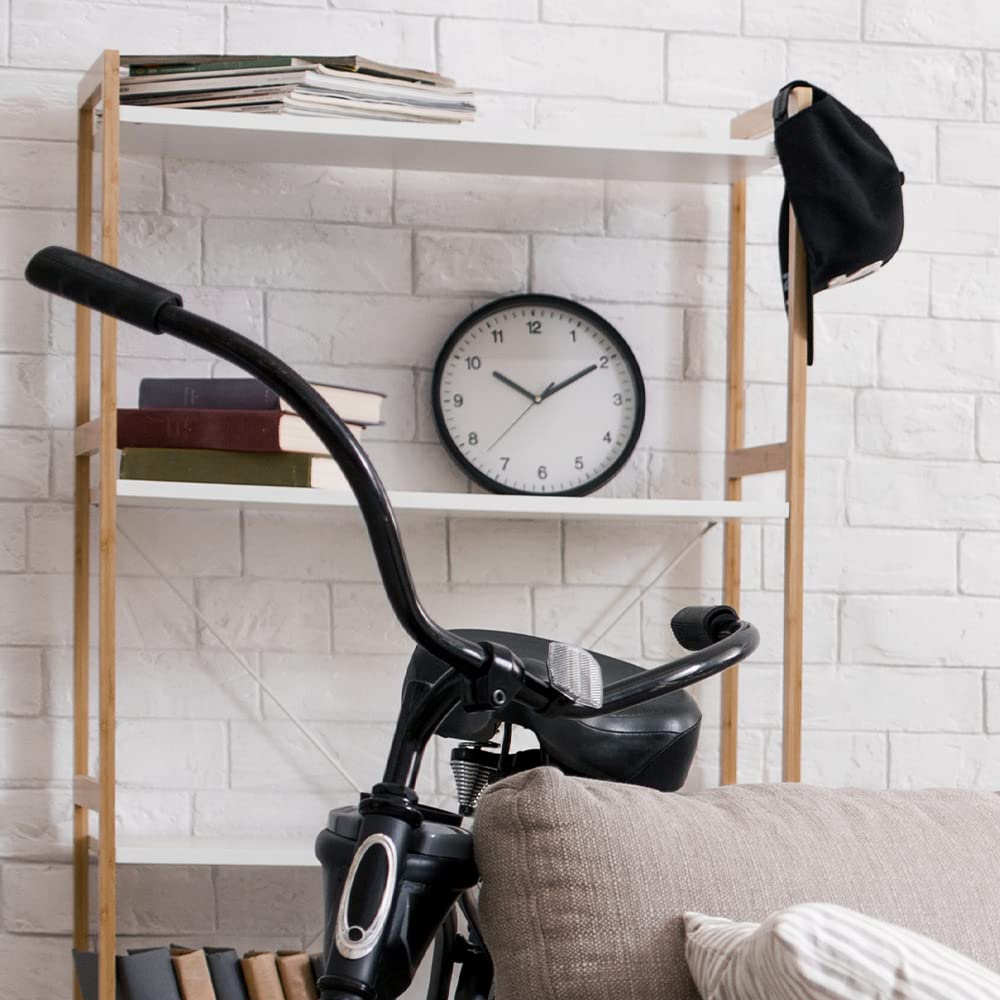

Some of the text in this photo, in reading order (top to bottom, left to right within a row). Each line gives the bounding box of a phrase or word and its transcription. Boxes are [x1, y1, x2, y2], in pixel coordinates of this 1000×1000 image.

[526, 320, 542, 335] 12
[491, 329, 503, 344] 11
[569, 330, 577, 343] 1
[464, 355, 482, 370] 10
[600, 355, 609, 369] 2
[453, 393, 464, 408] 9
[613, 393, 623, 406] 3
[468, 431, 479, 446] 8
[602, 431, 612, 444] 4
[499, 457, 510, 471] 7
[574, 456, 584, 470] 5
[537, 466, 548, 480] 6
